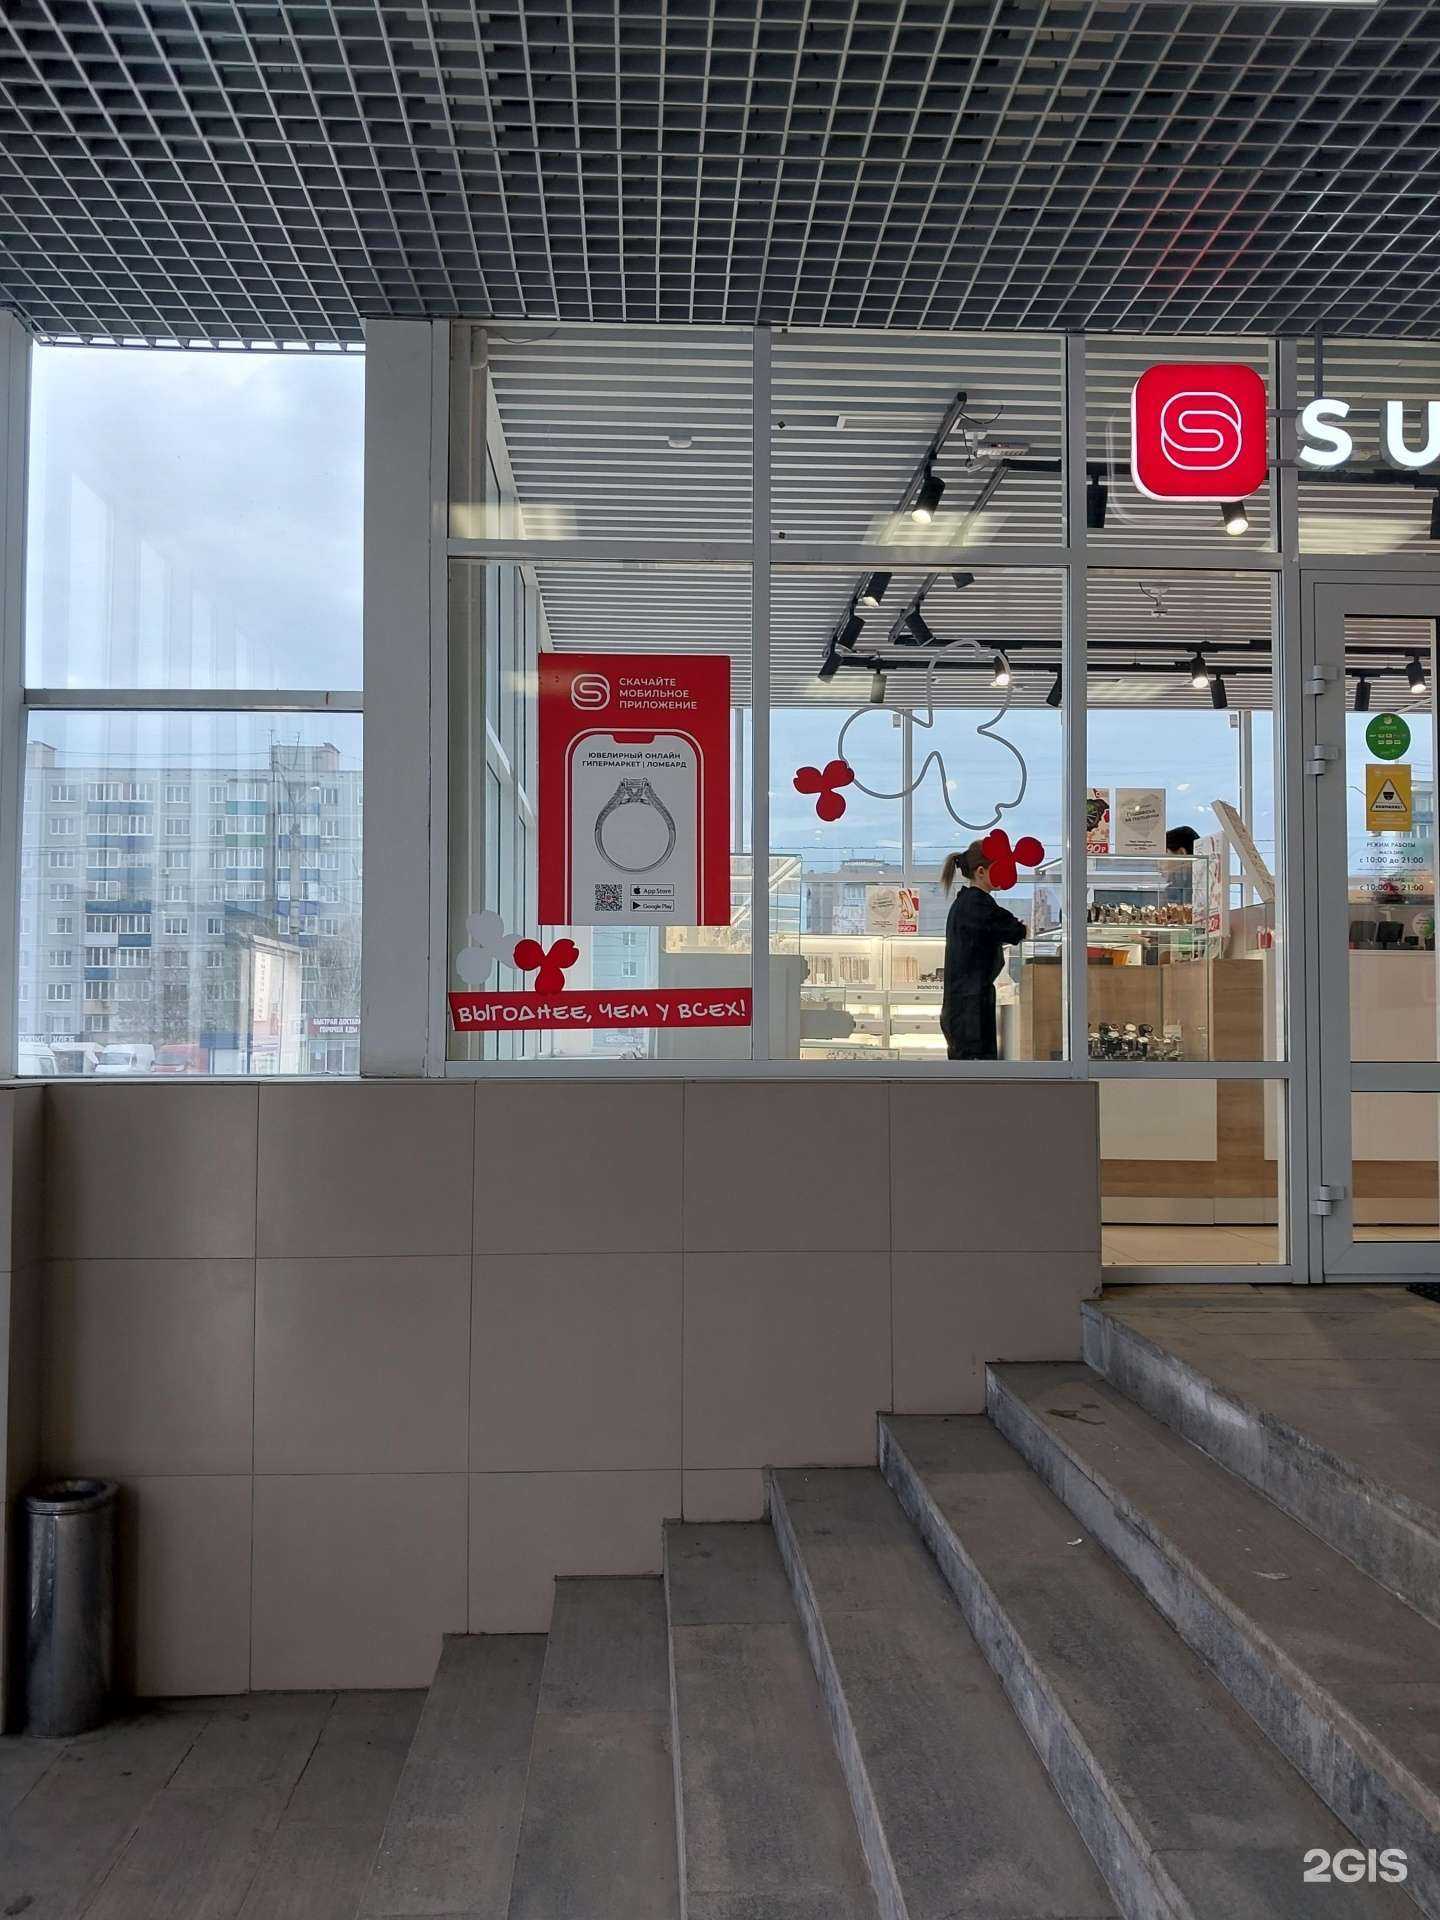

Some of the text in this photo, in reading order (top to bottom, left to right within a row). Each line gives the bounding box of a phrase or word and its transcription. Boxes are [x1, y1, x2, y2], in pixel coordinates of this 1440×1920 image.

[619, 676, 677, 686] СКАЧАЙТЕ
[619, 689, 689, 698] МОБИЛЬНОЕ
[619, 700, 697, 710] ПРИЛОЖЕНИЕ
[1401, 856, 1424, 864] 21:00
[1401, 883, 1424, 891] 21:00
[458, 999, 746, 1023] ВЫГОДНЕЕ, ЧЕМ У ВСЕХ!
